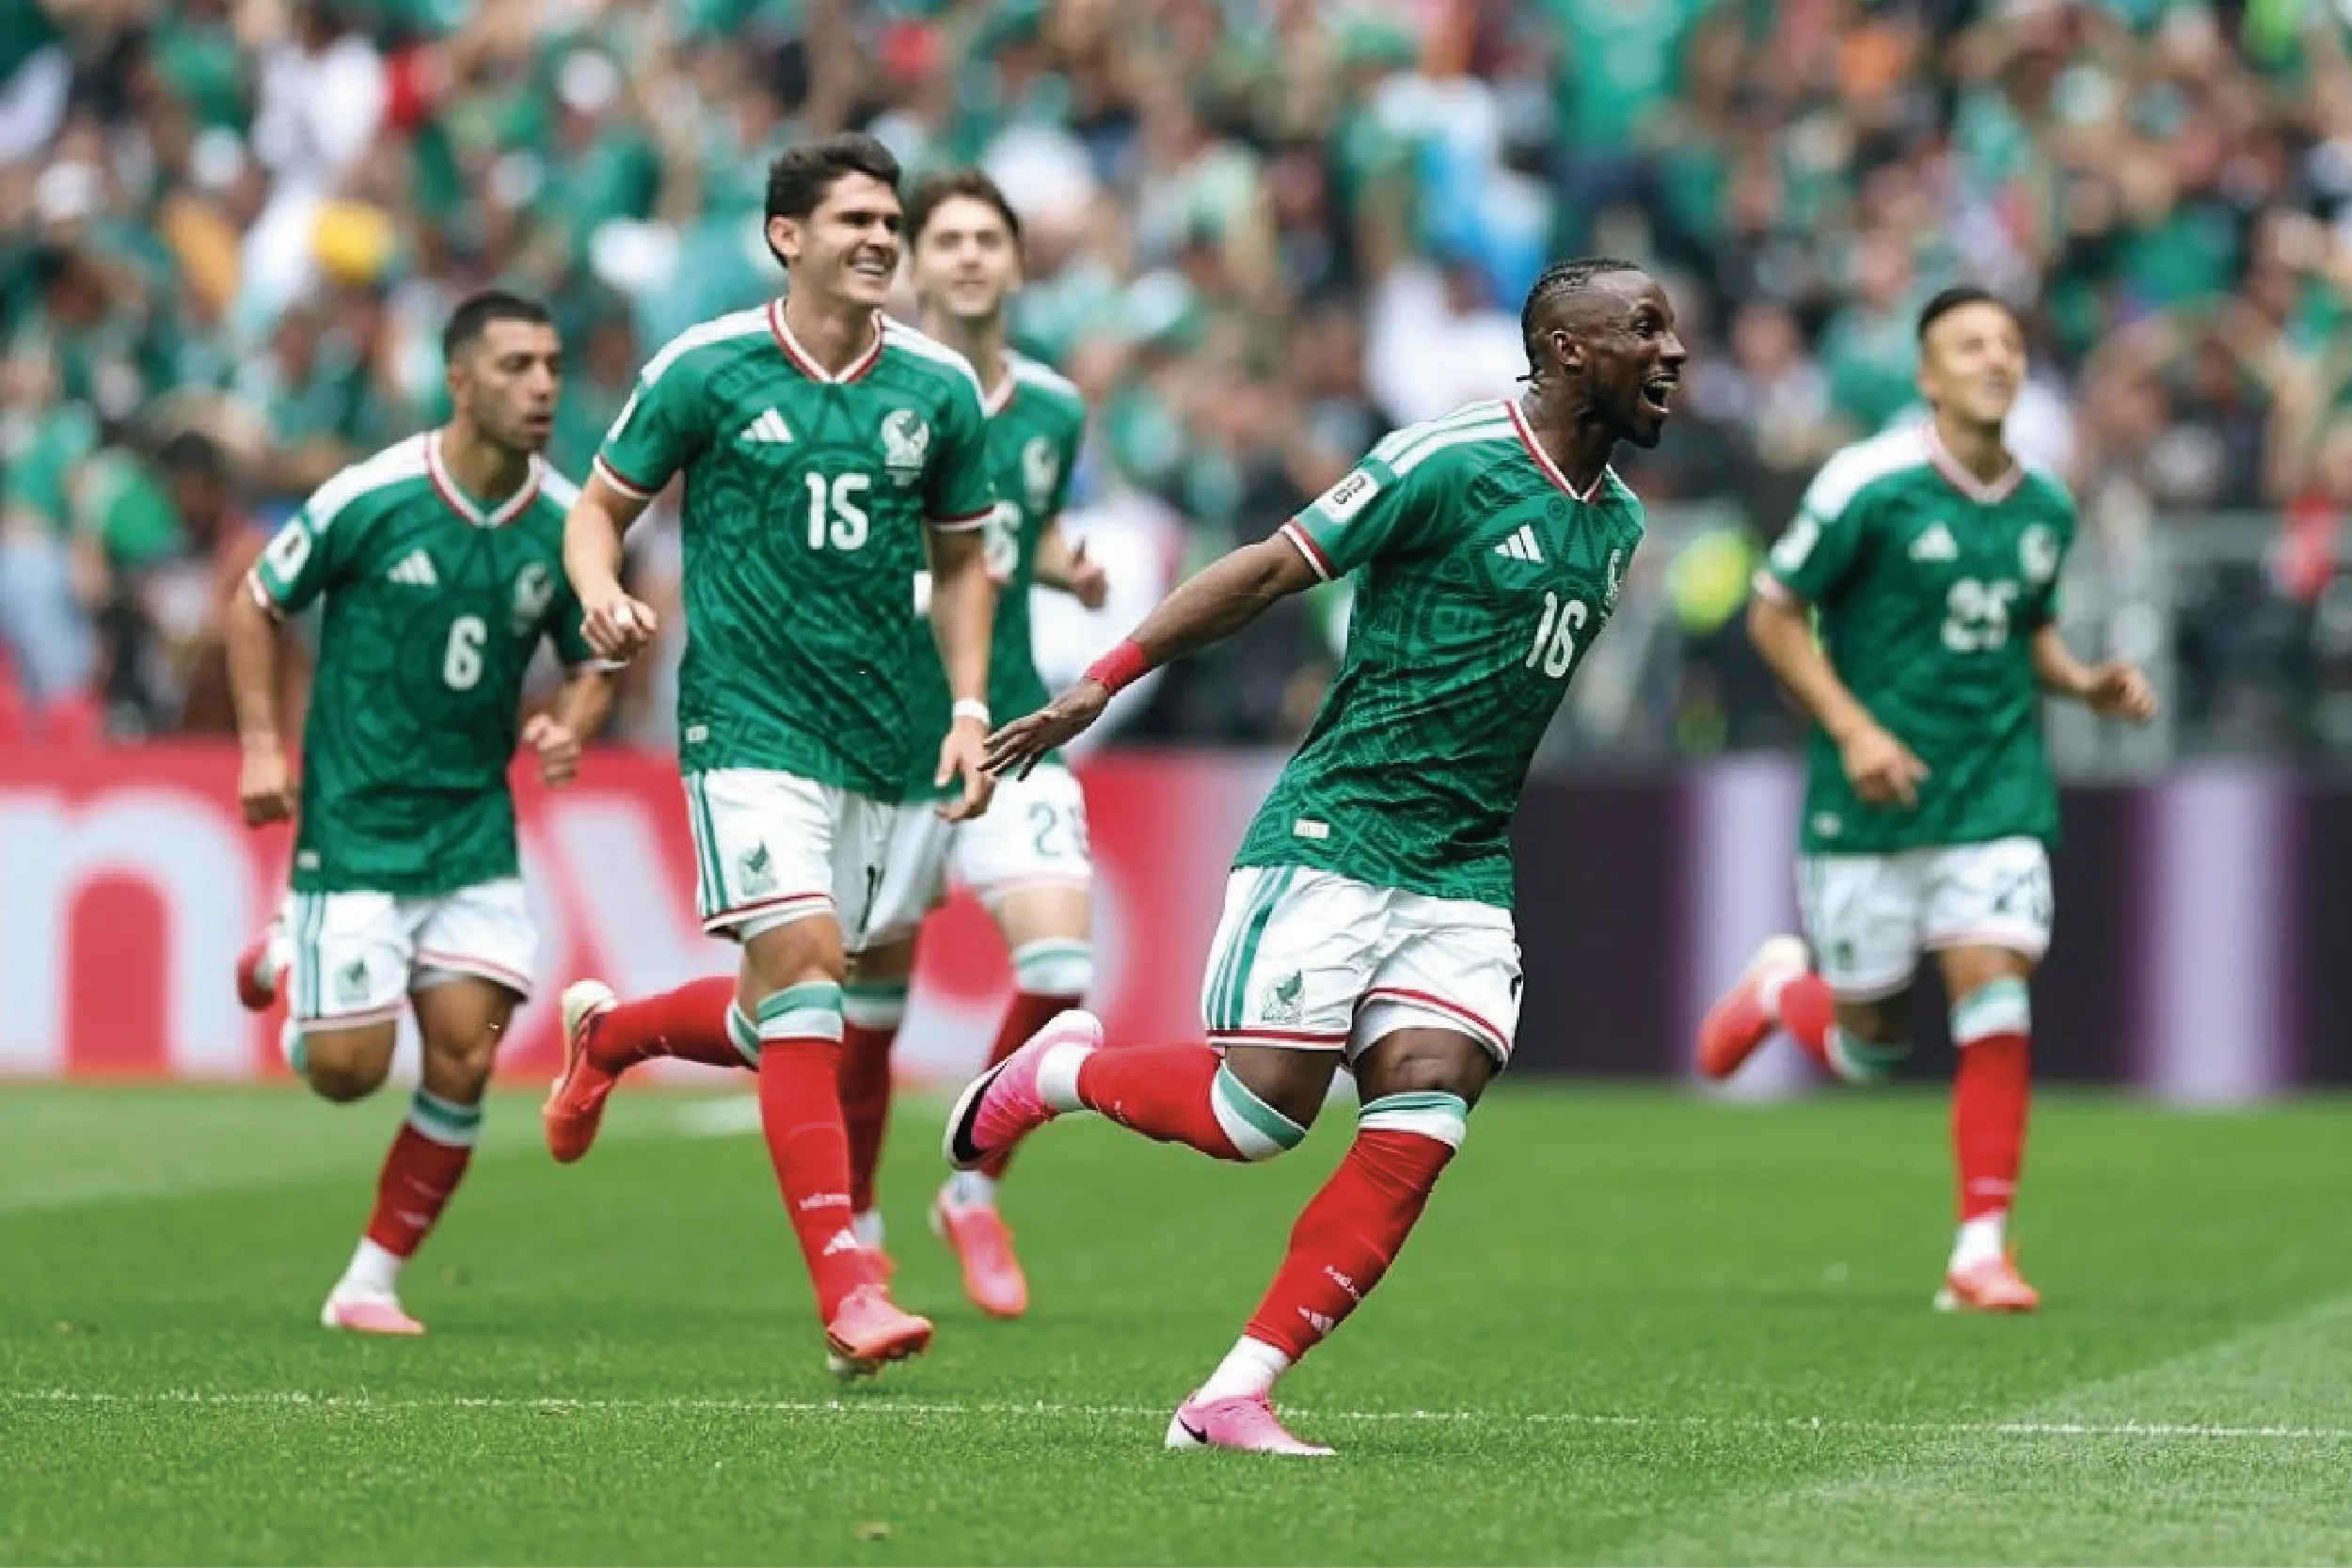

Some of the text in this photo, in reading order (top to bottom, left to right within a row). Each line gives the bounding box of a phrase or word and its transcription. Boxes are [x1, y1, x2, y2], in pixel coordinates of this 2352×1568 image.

[805, 472, 870, 549] 15
[443, 615, 487, 690] 6
[1526, 591, 1588, 678] 16
